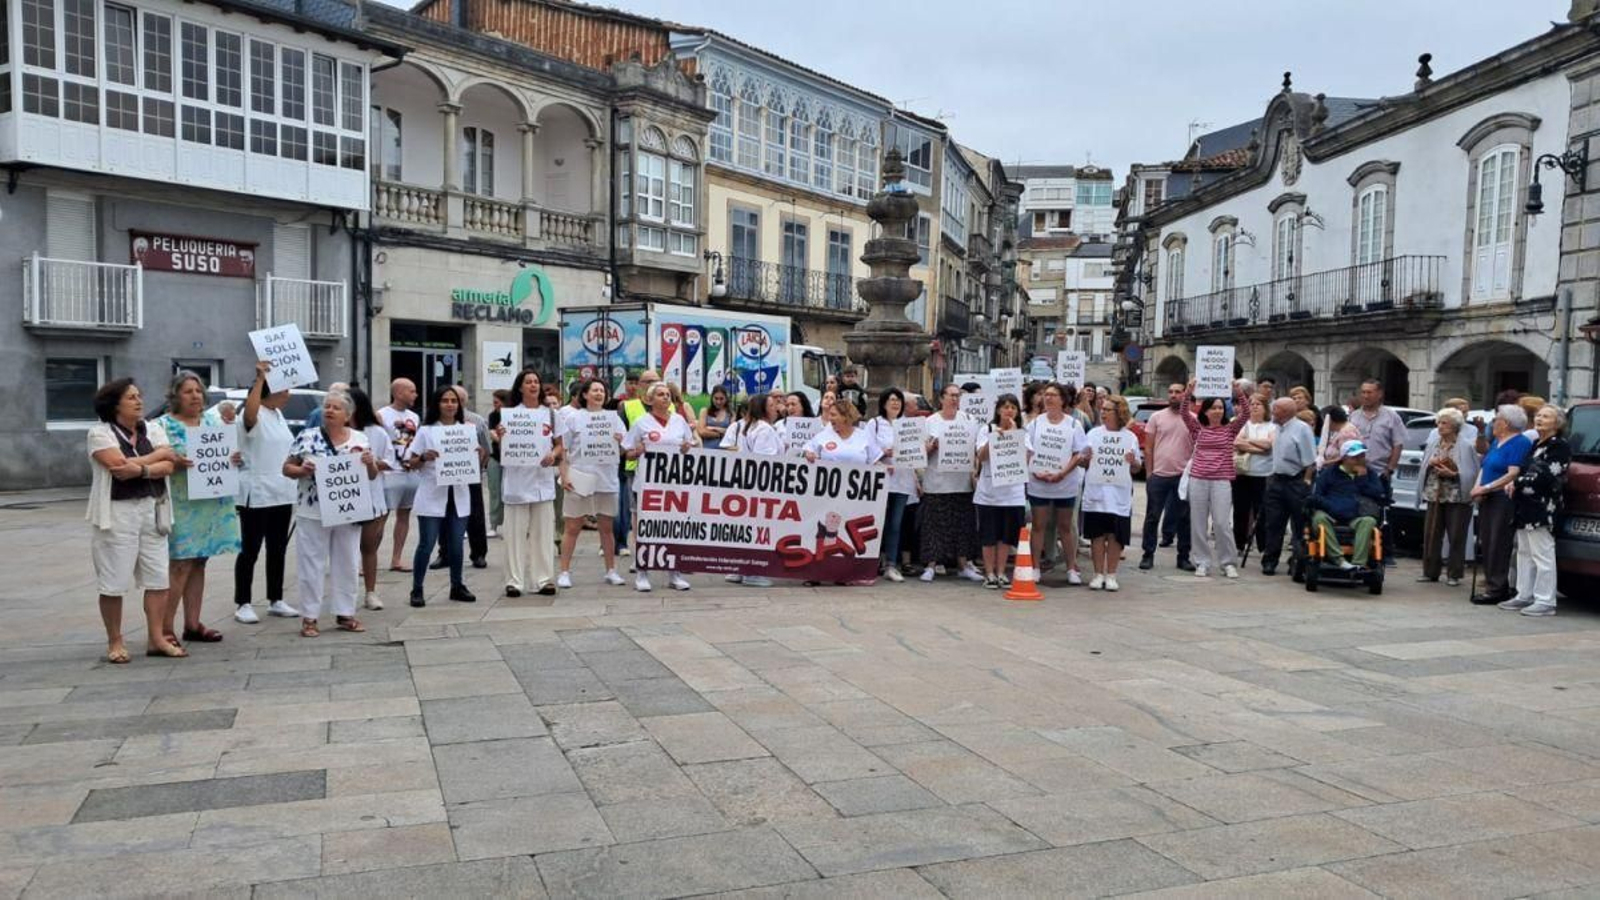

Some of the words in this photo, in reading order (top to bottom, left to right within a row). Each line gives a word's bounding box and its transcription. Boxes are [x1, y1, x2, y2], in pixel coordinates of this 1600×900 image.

[153, 236, 236, 257] PELUQUERIA
[171, 252, 220, 273] SUSO
[452, 302, 533, 324] RECLAMO
[265, 331, 287, 343] SAF
[264, 341, 297, 356] SOLU
[282, 367, 298, 379] XA
[795, 422, 812, 430] SAF
[200, 432, 224, 444] SAF
[1102, 436, 1122, 444] SAF
[196, 447, 230, 459] SOLU
[1098, 446, 1125, 456] SOLU
[328, 460, 352, 473] SAF
[444, 460, 472, 468] MENOS
[644, 451, 809, 496] TRABALLADORES
[814, 466, 842, 498] DO
[846, 468, 886, 501] SAF
[1102, 468, 1116, 476] XA
[206, 476, 223, 486] XA
[324, 474, 360, 488] SOLU
[338, 502, 356, 514] XA
[642, 490, 690, 513] EN
[701, 493, 802, 522] LOITA
[638, 516, 708, 540] CONDICIÓNS
[710, 522, 753, 544] DIGNAS
[755, 526, 771, 546] XA
[636, 544, 676, 569] CIG
